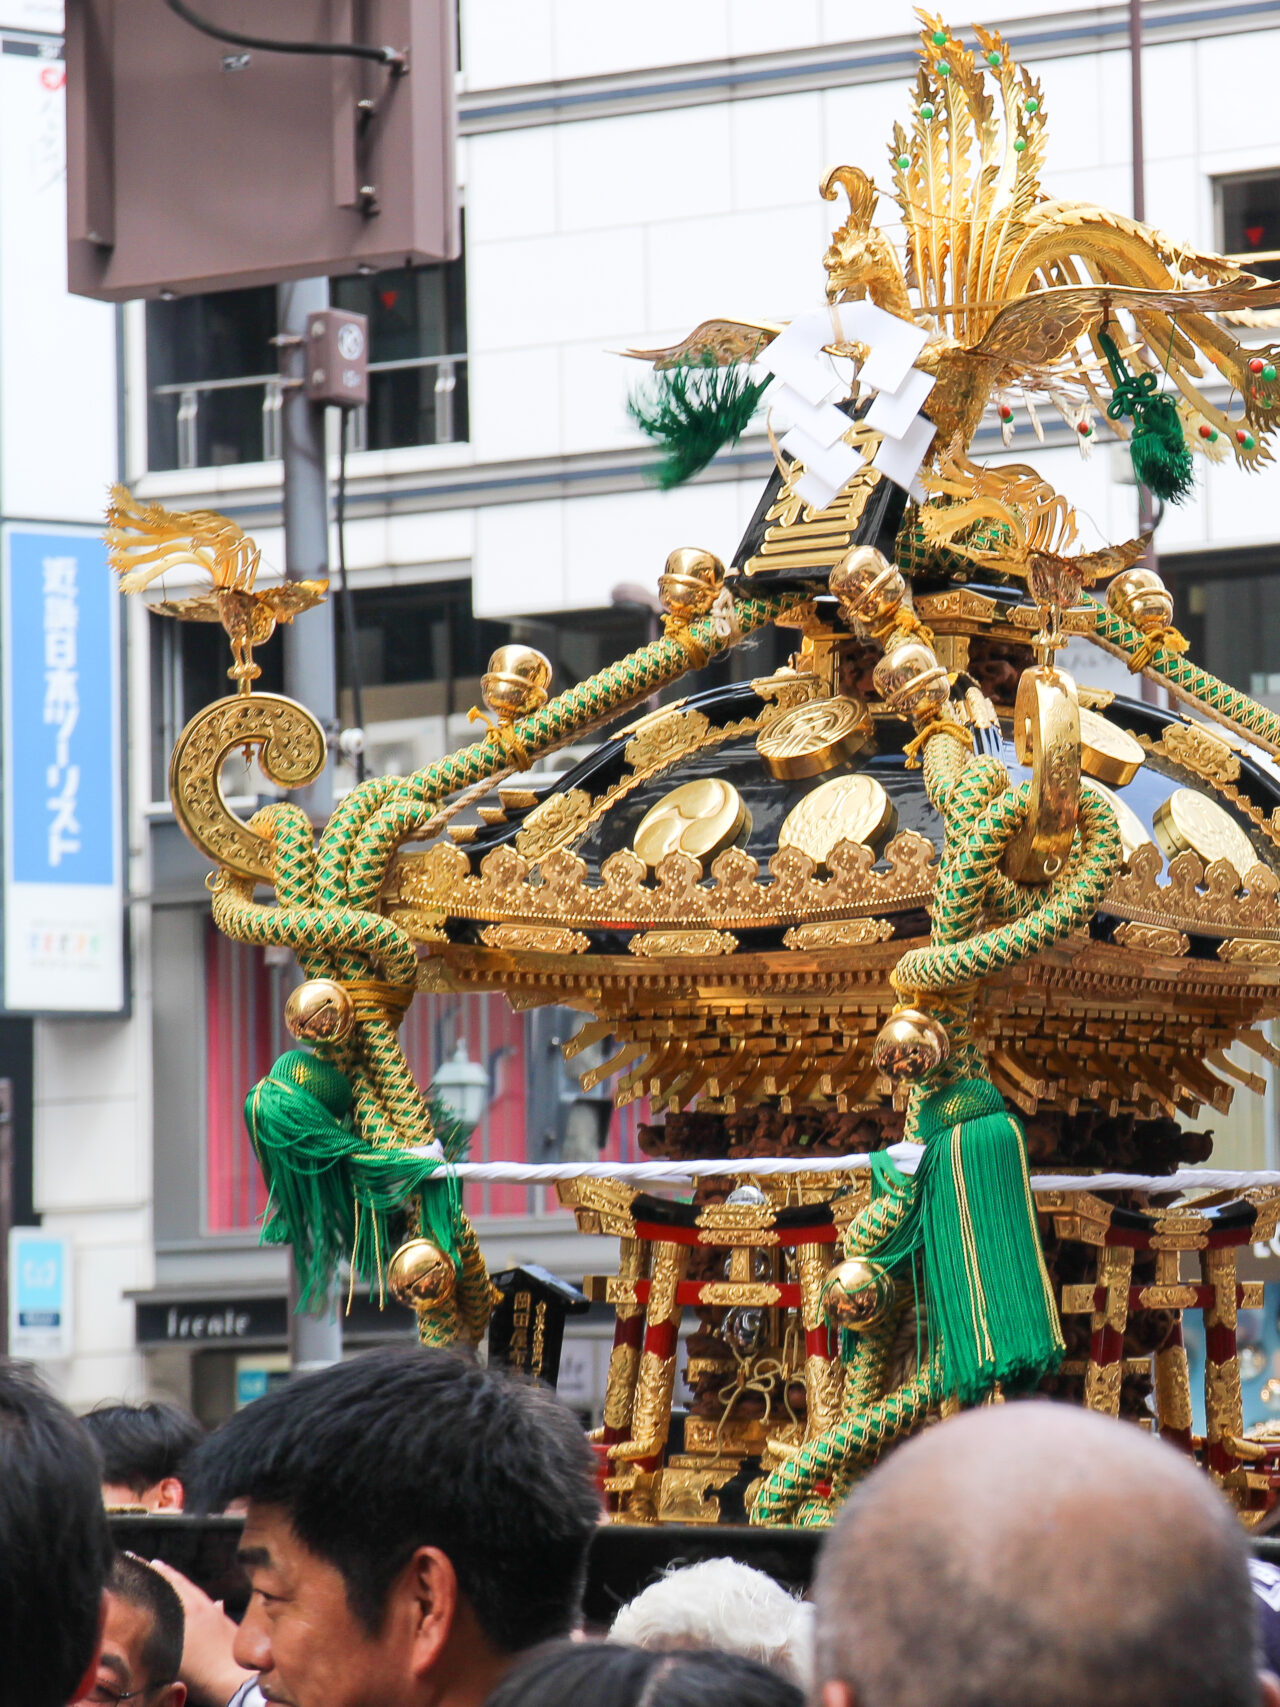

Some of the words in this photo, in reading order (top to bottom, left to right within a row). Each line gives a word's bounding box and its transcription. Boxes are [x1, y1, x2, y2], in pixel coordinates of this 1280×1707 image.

[42, 556, 80, 867] 近畿日本ツーリスト
